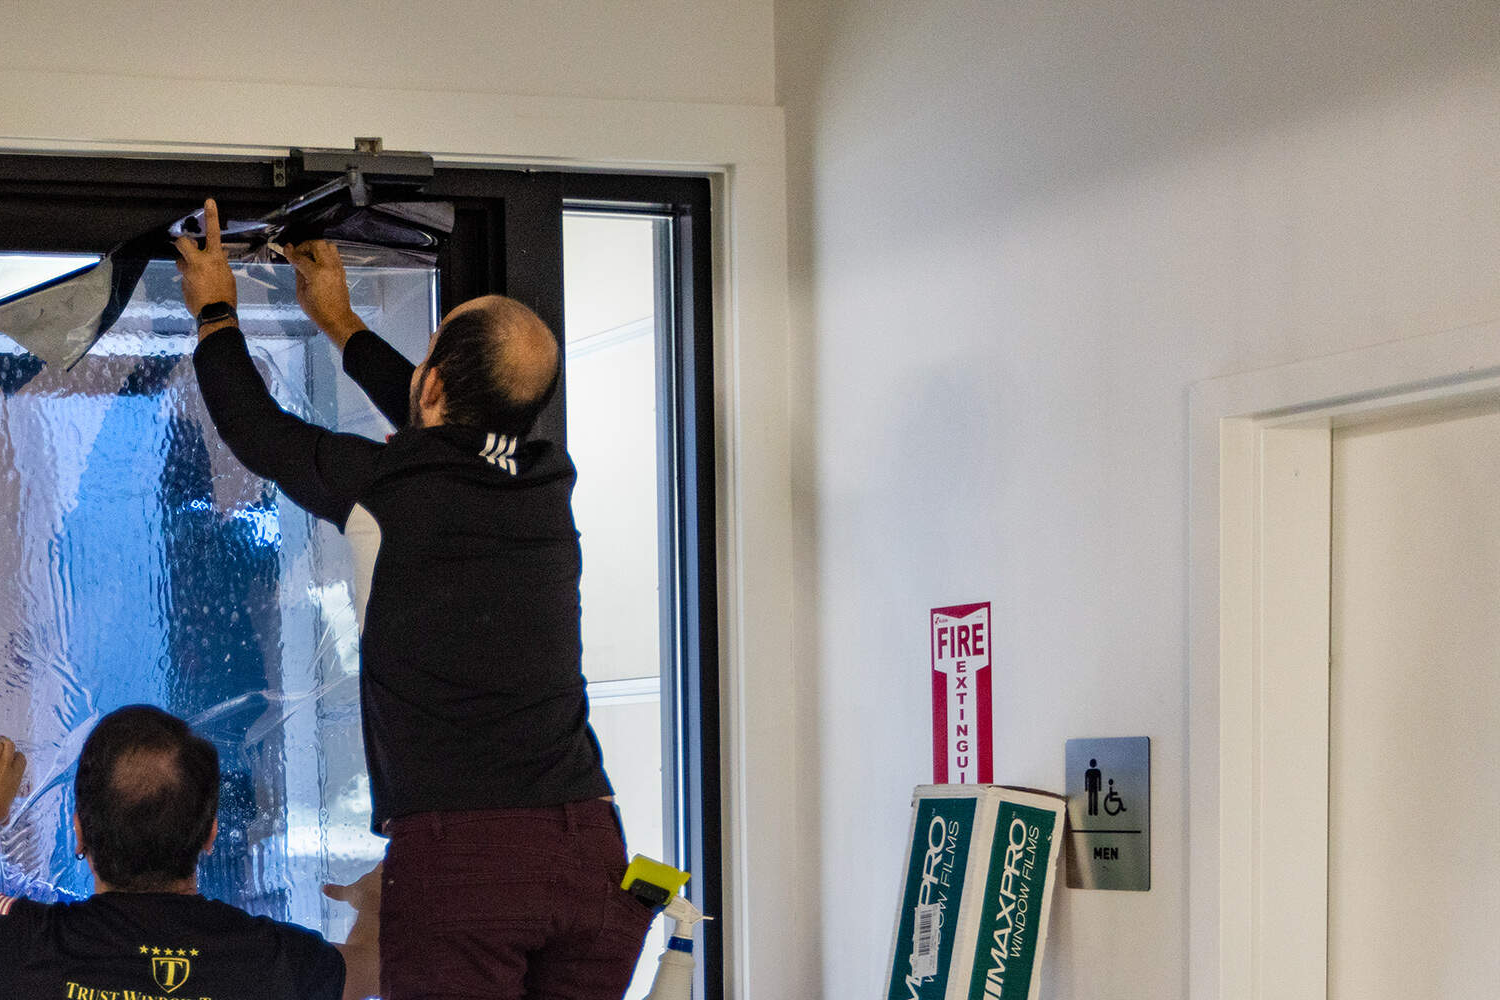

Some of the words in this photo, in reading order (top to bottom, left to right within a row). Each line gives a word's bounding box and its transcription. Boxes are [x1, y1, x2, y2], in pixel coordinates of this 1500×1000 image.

[937, 623, 985, 660] FIRE
[955, 661, 969, 784] EXTINGUI
[941, 820, 960, 888] FILMS
[1093, 847, 1119, 860] MEN
[985, 818, 1028, 986] MAXPRO
[1009, 882, 1031, 958] WINDOW
[1022, 824, 1040, 882] FILMS
[159, 960, 184, 986] T
